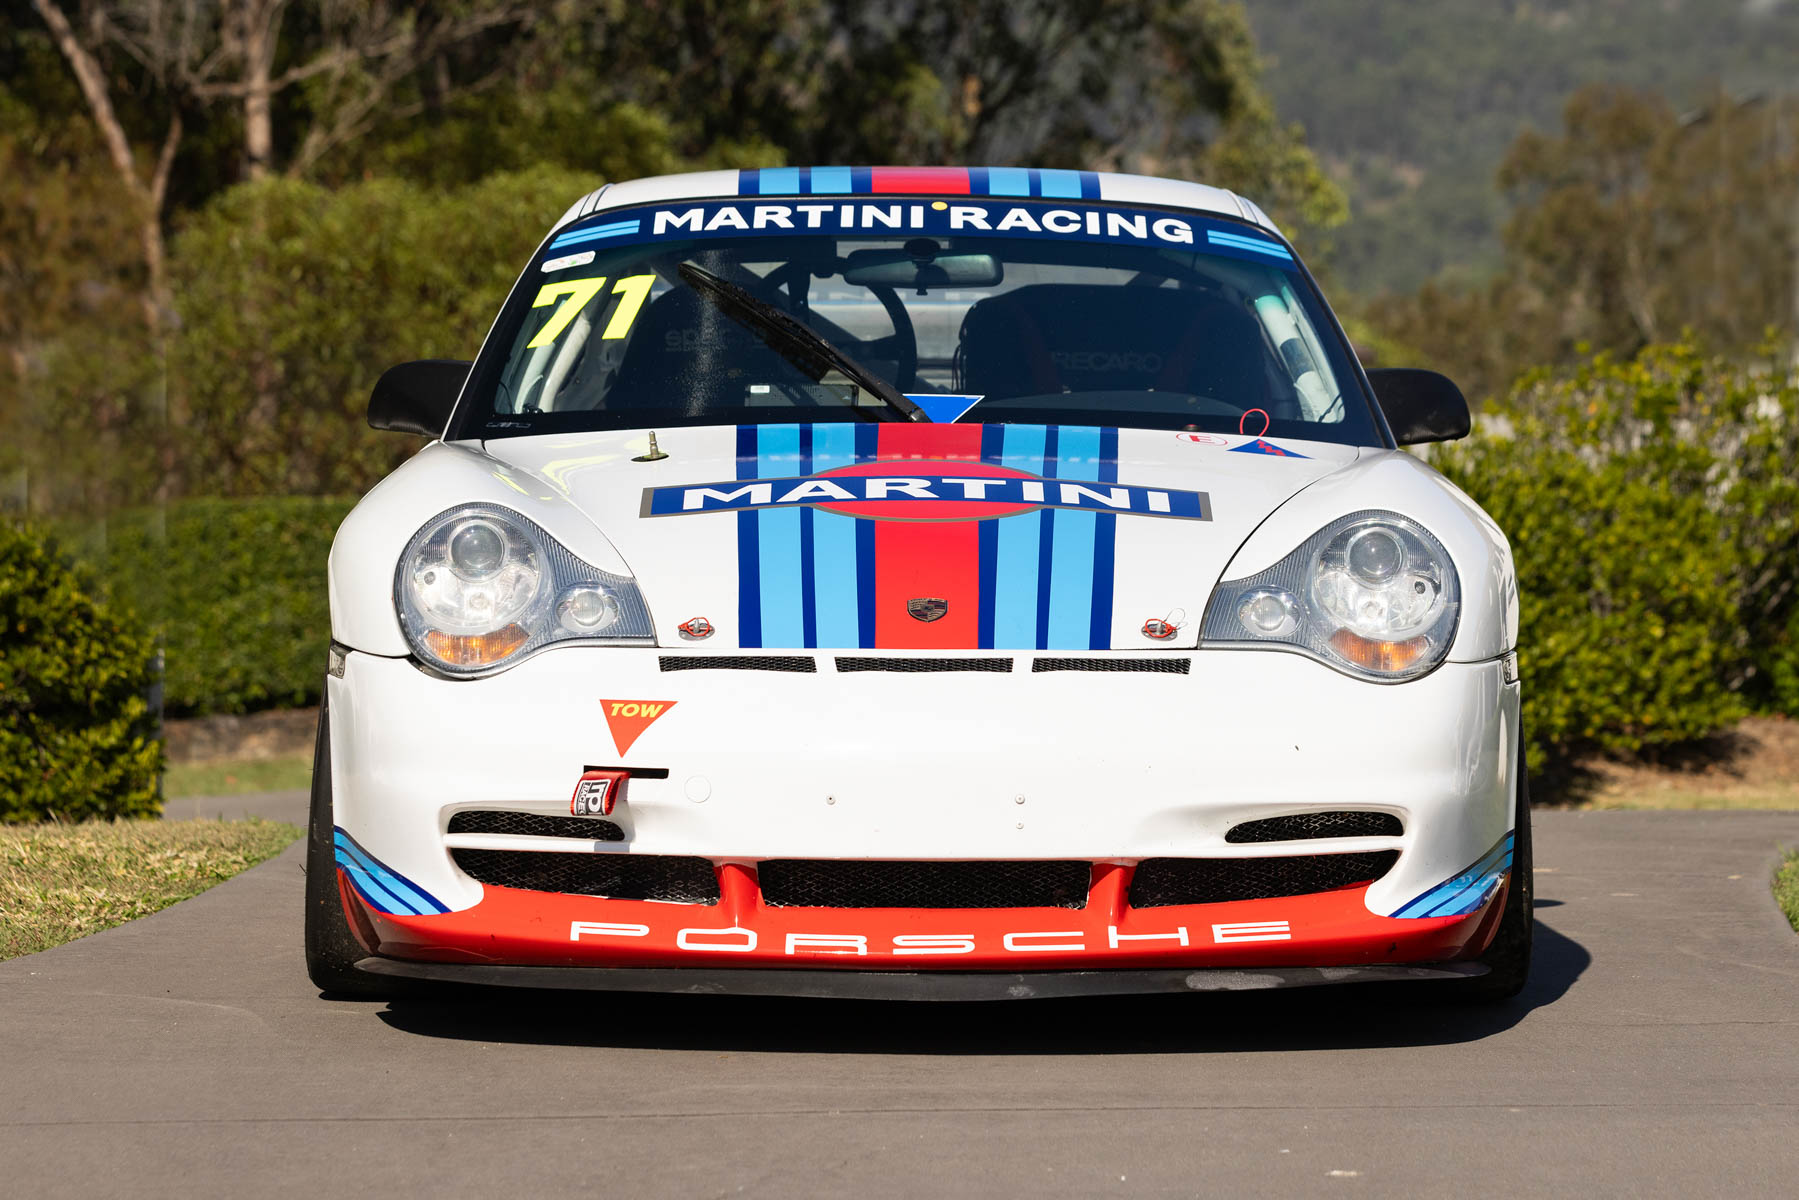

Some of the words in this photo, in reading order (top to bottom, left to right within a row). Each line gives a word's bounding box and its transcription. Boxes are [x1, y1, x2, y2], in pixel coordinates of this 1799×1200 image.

[653, 205, 924, 235] MARTINI
[950, 206, 1194, 244] RACING
[527, 274, 657, 349] 71
[1051, 351, 1162, 373] RECARO
[682, 478, 1171, 513] MARTINI
[611, 703, 664, 718] TOW
[570, 920, 1292, 956] PORSCHE
